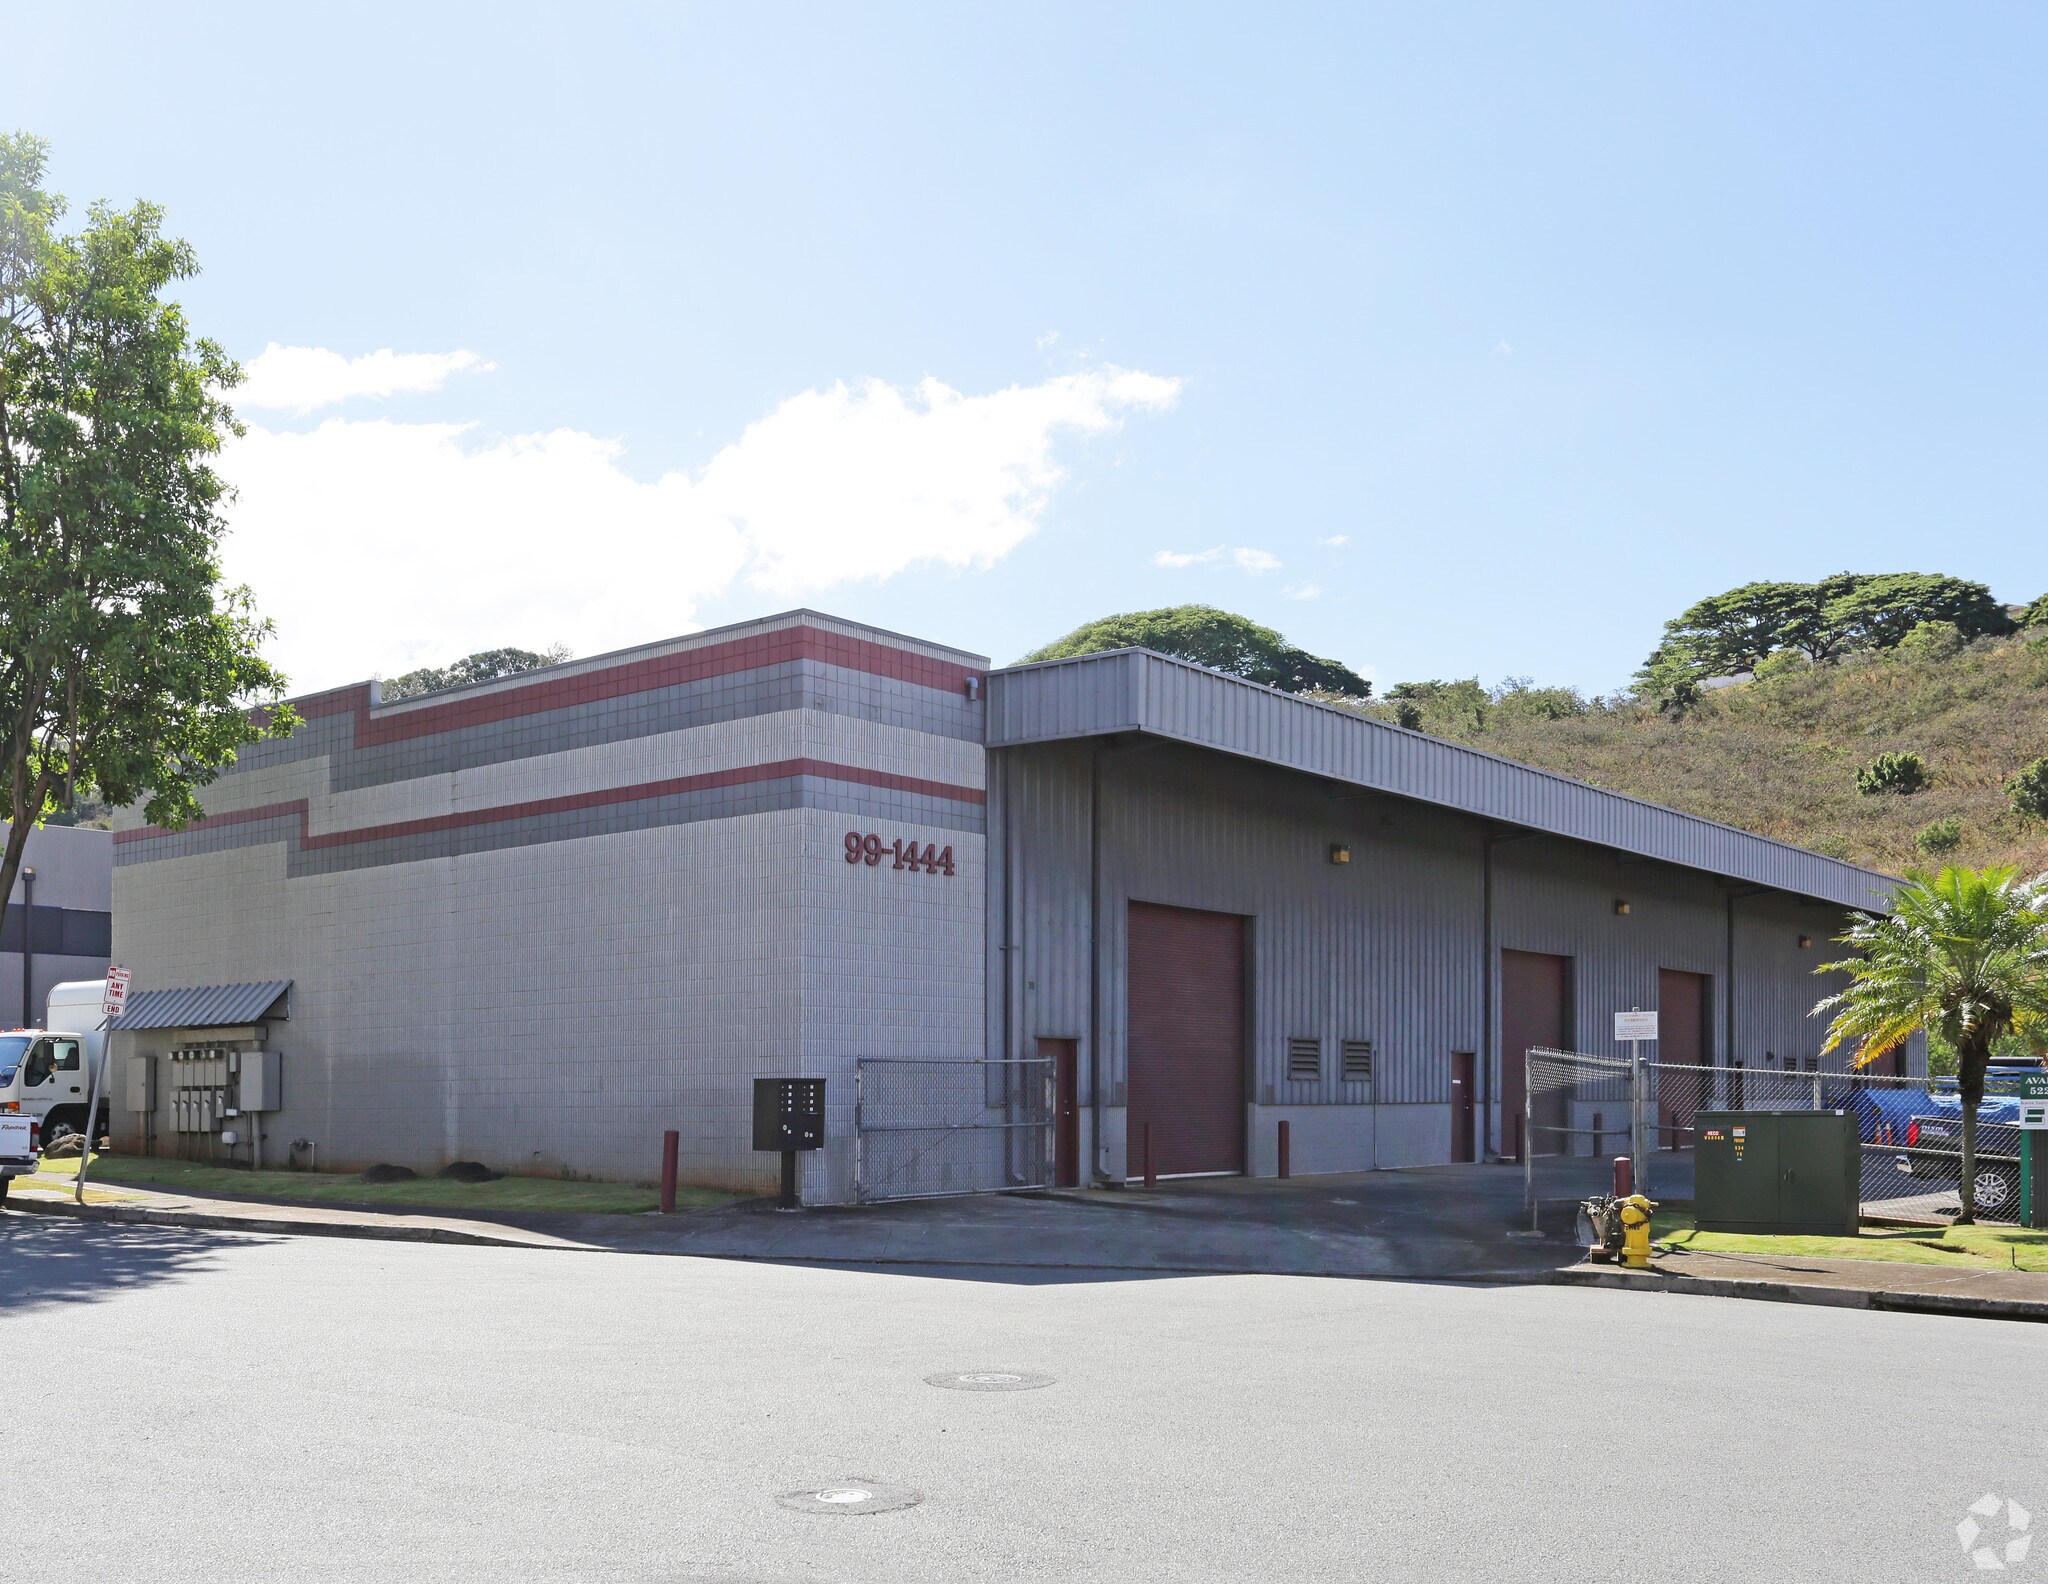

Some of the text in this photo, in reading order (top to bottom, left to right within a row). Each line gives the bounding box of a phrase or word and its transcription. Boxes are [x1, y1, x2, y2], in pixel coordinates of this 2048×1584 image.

[844, 831, 955, 876] 99-1444
[111, 982, 124, 990] ANY
[109, 990, 124, 998] TIME
[107, 1005, 120, 1013] END
